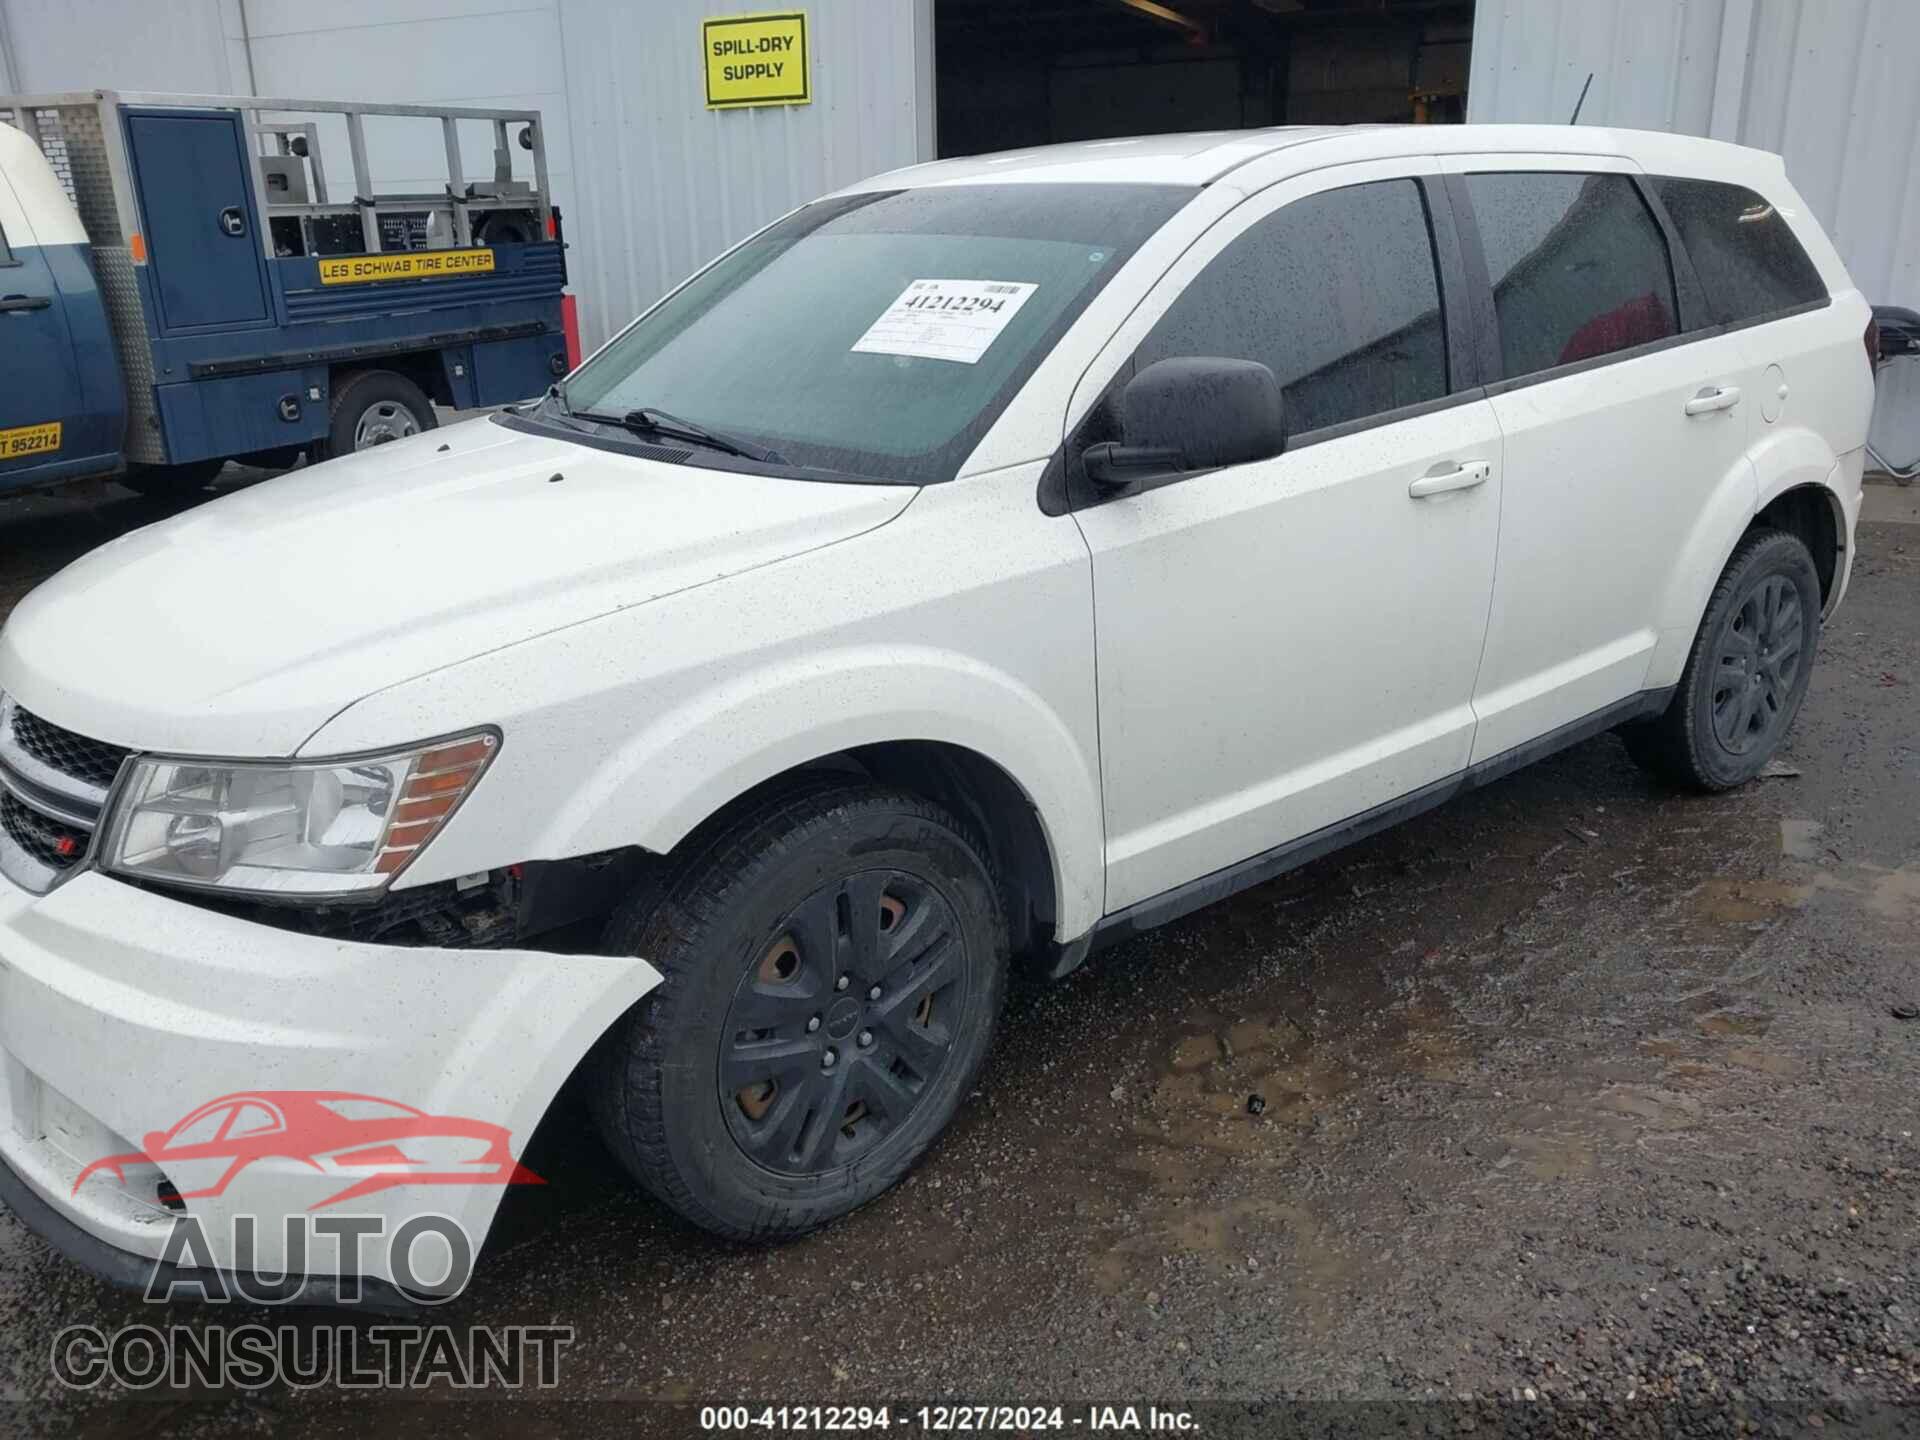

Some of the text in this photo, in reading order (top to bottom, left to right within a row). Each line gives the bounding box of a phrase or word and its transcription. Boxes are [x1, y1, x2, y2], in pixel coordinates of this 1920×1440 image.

[713, 36, 793, 56] SPILL-DRY
[723, 62, 784, 81] SUPPLY
[323, 254, 492, 278] LES SCHWAB TIRE CENTER
[905, 295, 1006, 312] 41212294
[12, 433, 57, 453] 952214
